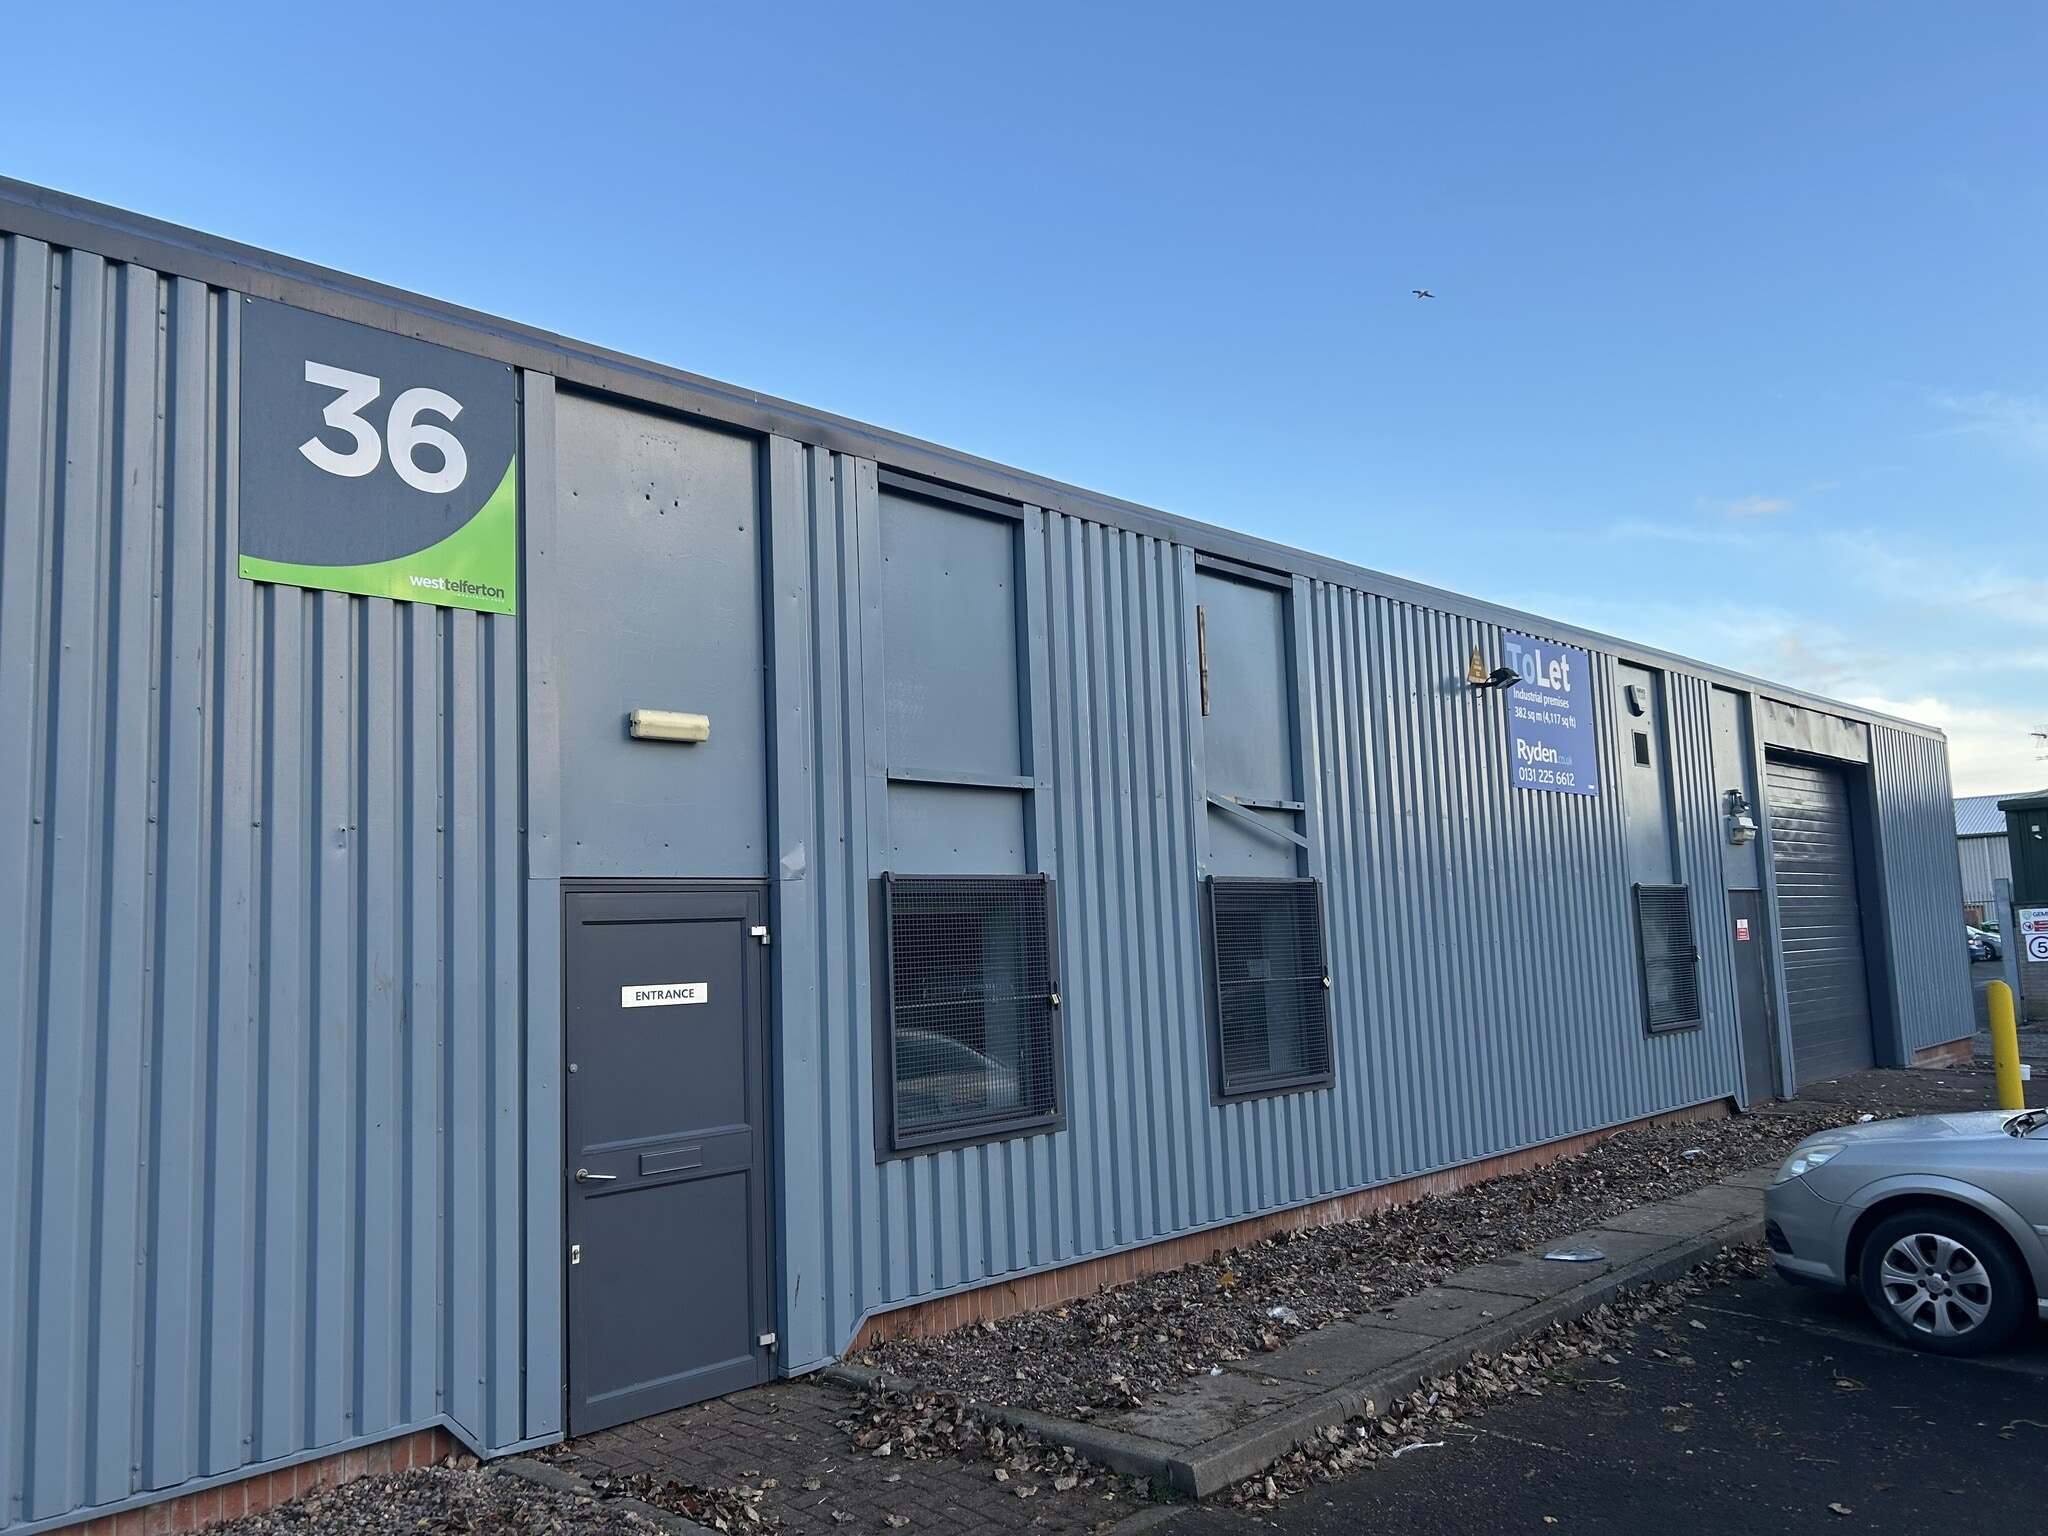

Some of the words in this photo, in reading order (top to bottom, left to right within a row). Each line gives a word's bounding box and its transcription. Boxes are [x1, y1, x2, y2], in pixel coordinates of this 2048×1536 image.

[299, 360, 468, 494] 36
[1513, 687, 1543, 703] Industrial
[1543, 696, 1570, 709] premises
[1514, 706, 1527, 719] 382
[1527, 710, 1536, 723] sq
[1536, 712, 1543, 722] m
[1543, 710, 1561, 724] (4,117
[1562, 717, 1570, 729] sq
[1569, 716, 1577, 729] ft)
[1518, 766, 1536, 782] 0131
[1538, 769, 1554, 784] 225
[1556, 772, 1575, 786] 6612
[2037, 941, 2048, 954] 5
[635, 988, 695, 1001] ENTRANCE
